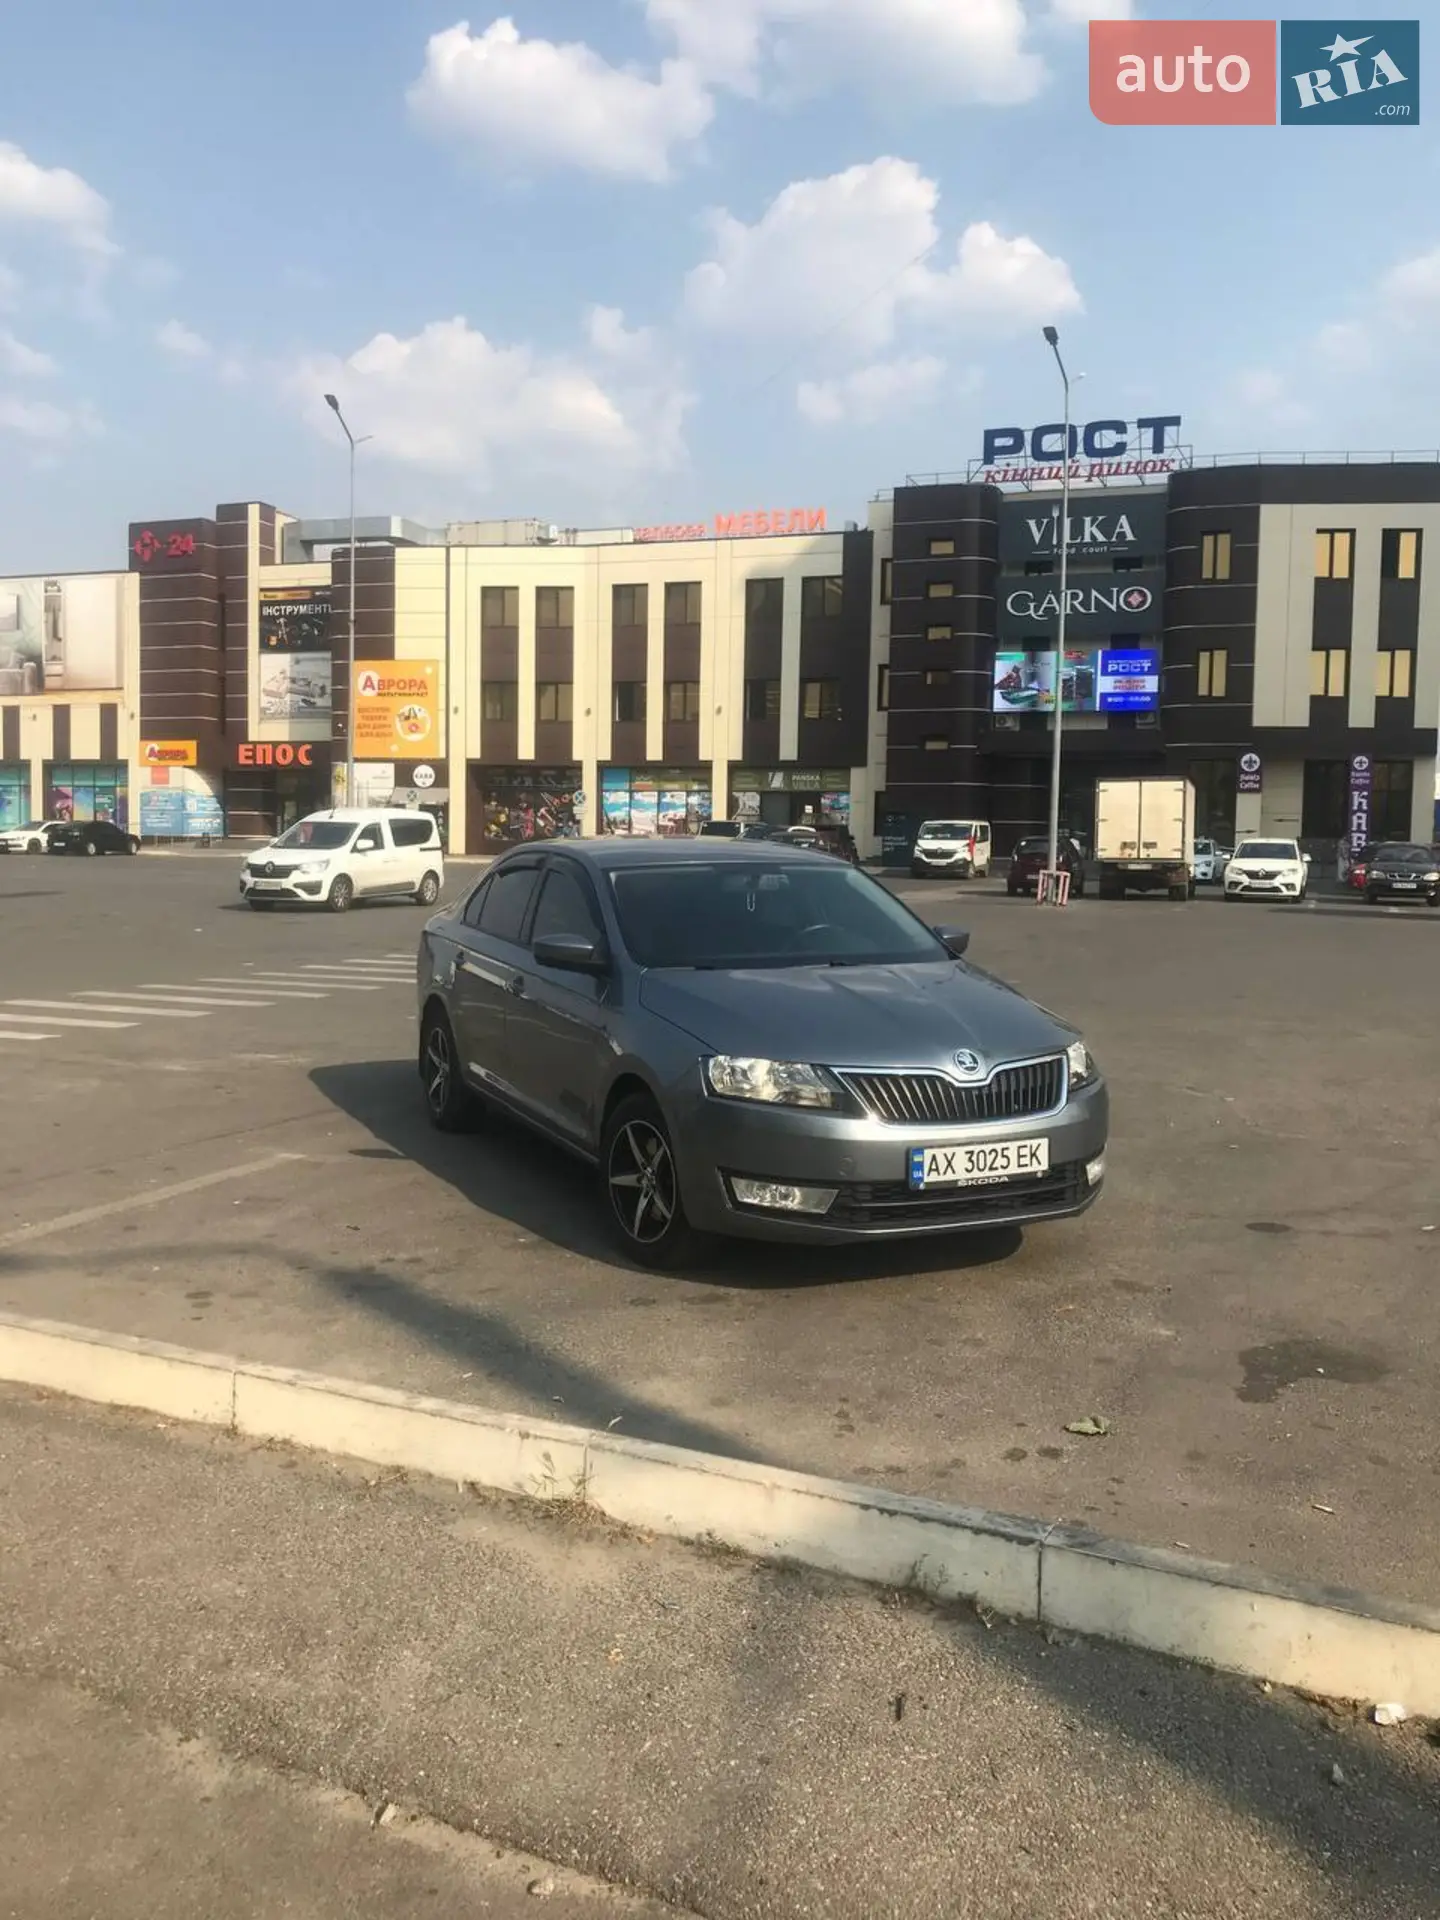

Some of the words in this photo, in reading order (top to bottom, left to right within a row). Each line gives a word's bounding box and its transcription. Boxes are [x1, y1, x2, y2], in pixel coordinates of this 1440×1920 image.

[983, 415, 1181, 465] РОСТ
[714, 507, 826, 536] МЕБЕЛИ
[1026, 504, 1137, 545] VILKA
[167, 532, 194, 558] 24
[1082, 545, 1108, 553] court
[1006, 586, 1152, 620] GARNO
[362, 675, 428, 691] АВРОРА
[238, 743, 313, 766] ЕПОС
[927, 1151, 956, 1177] AX
[964, 1148, 1011, 1173] 3025
[1016, 1143, 1042, 1168] EK
